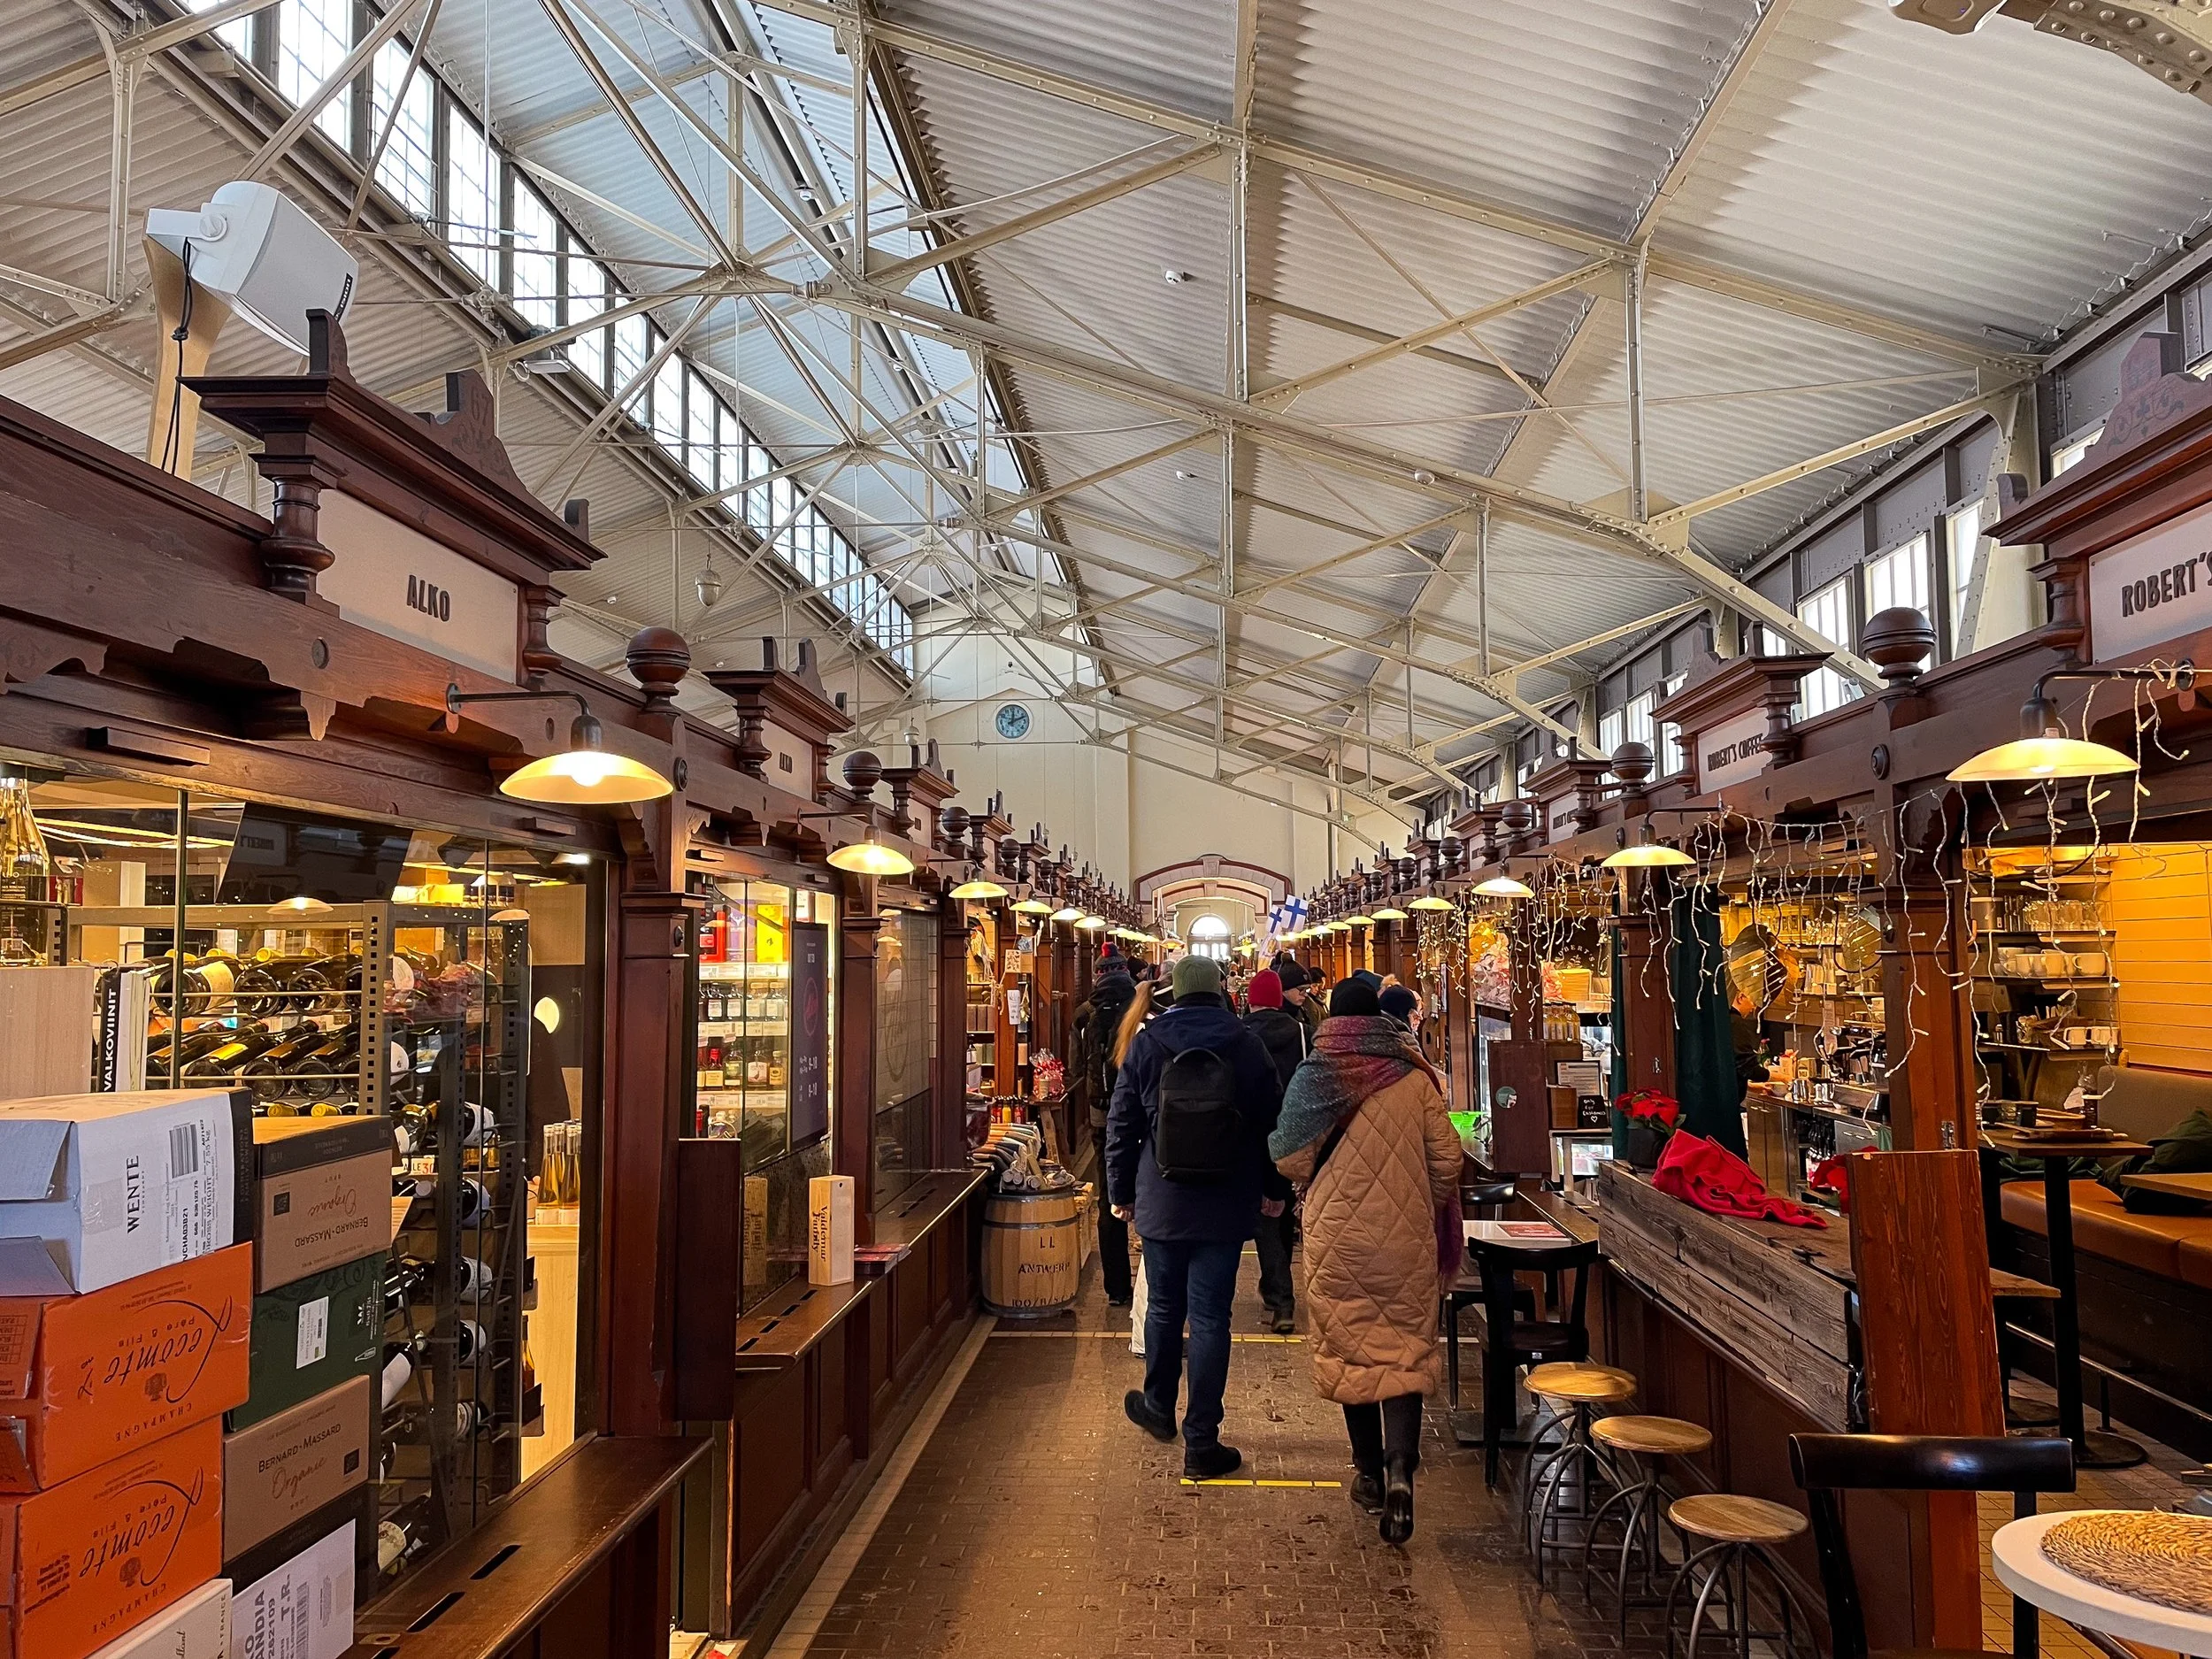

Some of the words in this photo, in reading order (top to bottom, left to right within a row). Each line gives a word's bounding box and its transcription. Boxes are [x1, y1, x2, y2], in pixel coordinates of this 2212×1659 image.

[407, 574, 451, 623] ALKO
[1707, 743, 1737, 772] ROBERT'S
[104, 987, 117, 1092] VALKOVIINIT
[126, 1155, 141, 1233] WENTE
[307, 1186, 357, 1218] Organic
[811, 1210, 821, 1253] Family
[1018, 1262, 1071, 1275] ANTWERP
[104, 1295, 233, 1404] Lecomte
[114, 1402, 193, 1442] CHAMPAGNE
[272, 1455, 327, 1500] Organic
[78, 1467, 204, 1586] Lecomte
[92, 1582, 168, 1633] CHAMPAGNE
